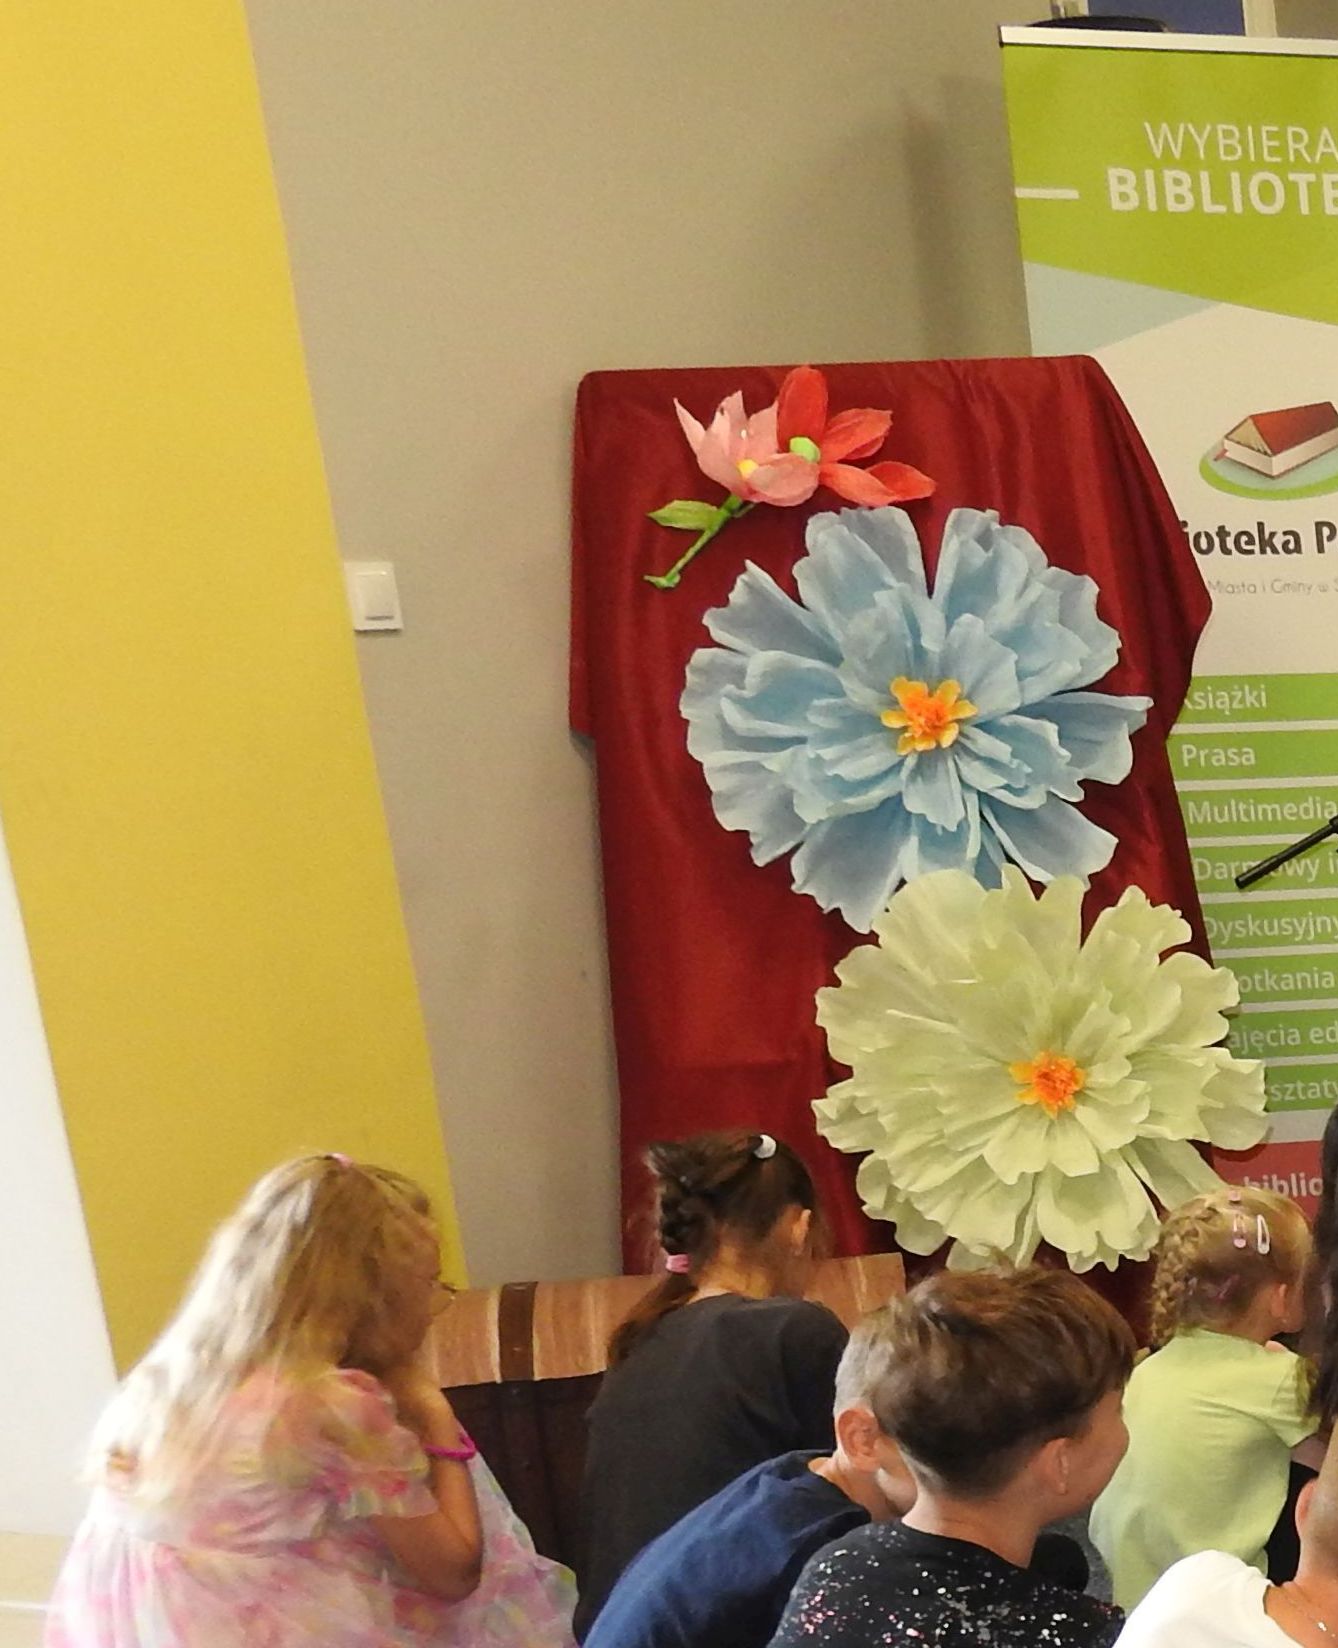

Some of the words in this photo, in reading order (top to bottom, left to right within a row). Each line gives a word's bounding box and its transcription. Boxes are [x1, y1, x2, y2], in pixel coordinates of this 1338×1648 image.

[1181, 520, 1303, 556] oteka
[1184, 683, 1268, 716] siążki
[1181, 743, 1257, 768] Prasa
[1187, 796, 1338, 825] Multimedia
[1194, 854, 1320, 882] Darwy
[1238, 966, 1336, 994] otkania
[1228, 1023, 1302, 1053] ajęcia
